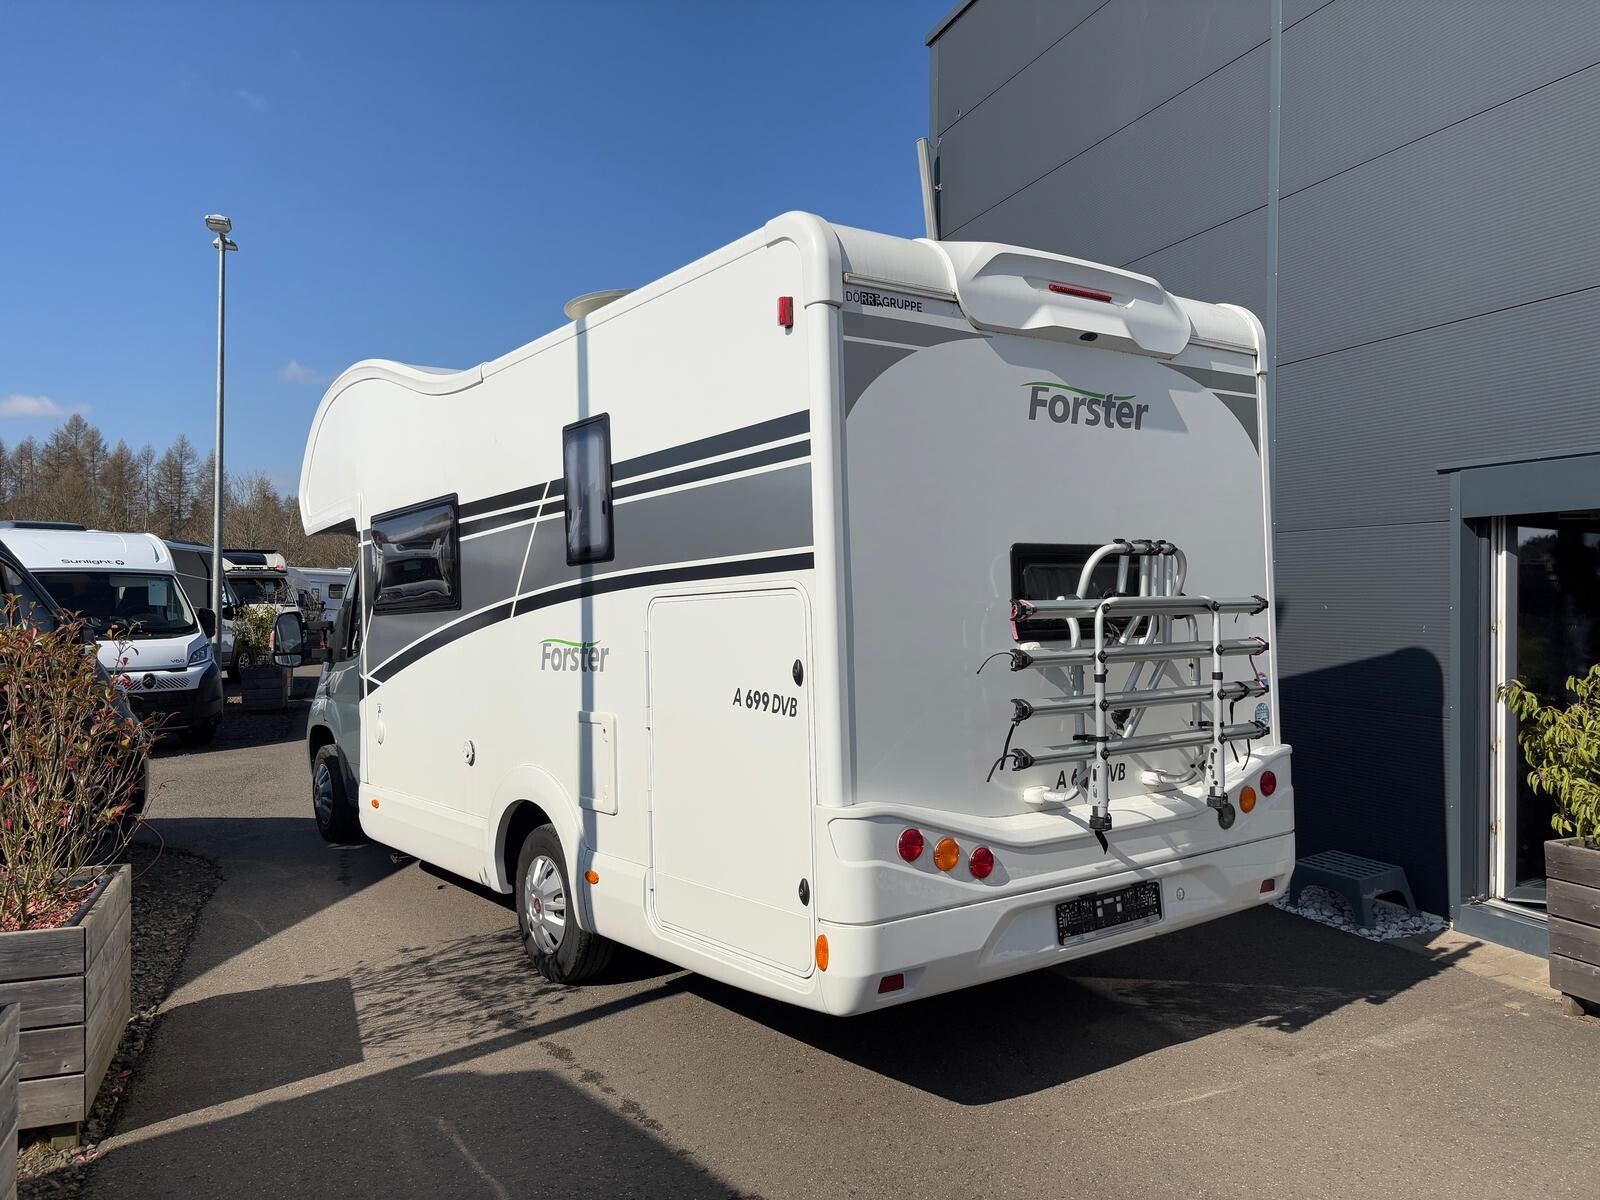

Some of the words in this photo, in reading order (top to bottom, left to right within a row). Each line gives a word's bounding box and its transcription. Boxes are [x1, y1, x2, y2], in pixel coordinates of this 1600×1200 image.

[1028, 386, 1149, 430] Forster
[541, 642, 609, 672] Forster
[732, 687, 742, 706] A
[745, 689, 769, 711] 699
[771, 694, 798, 717] DVB
[1056, 770, 1067, 789] A
[1107, 763, 1126, 782] VB
